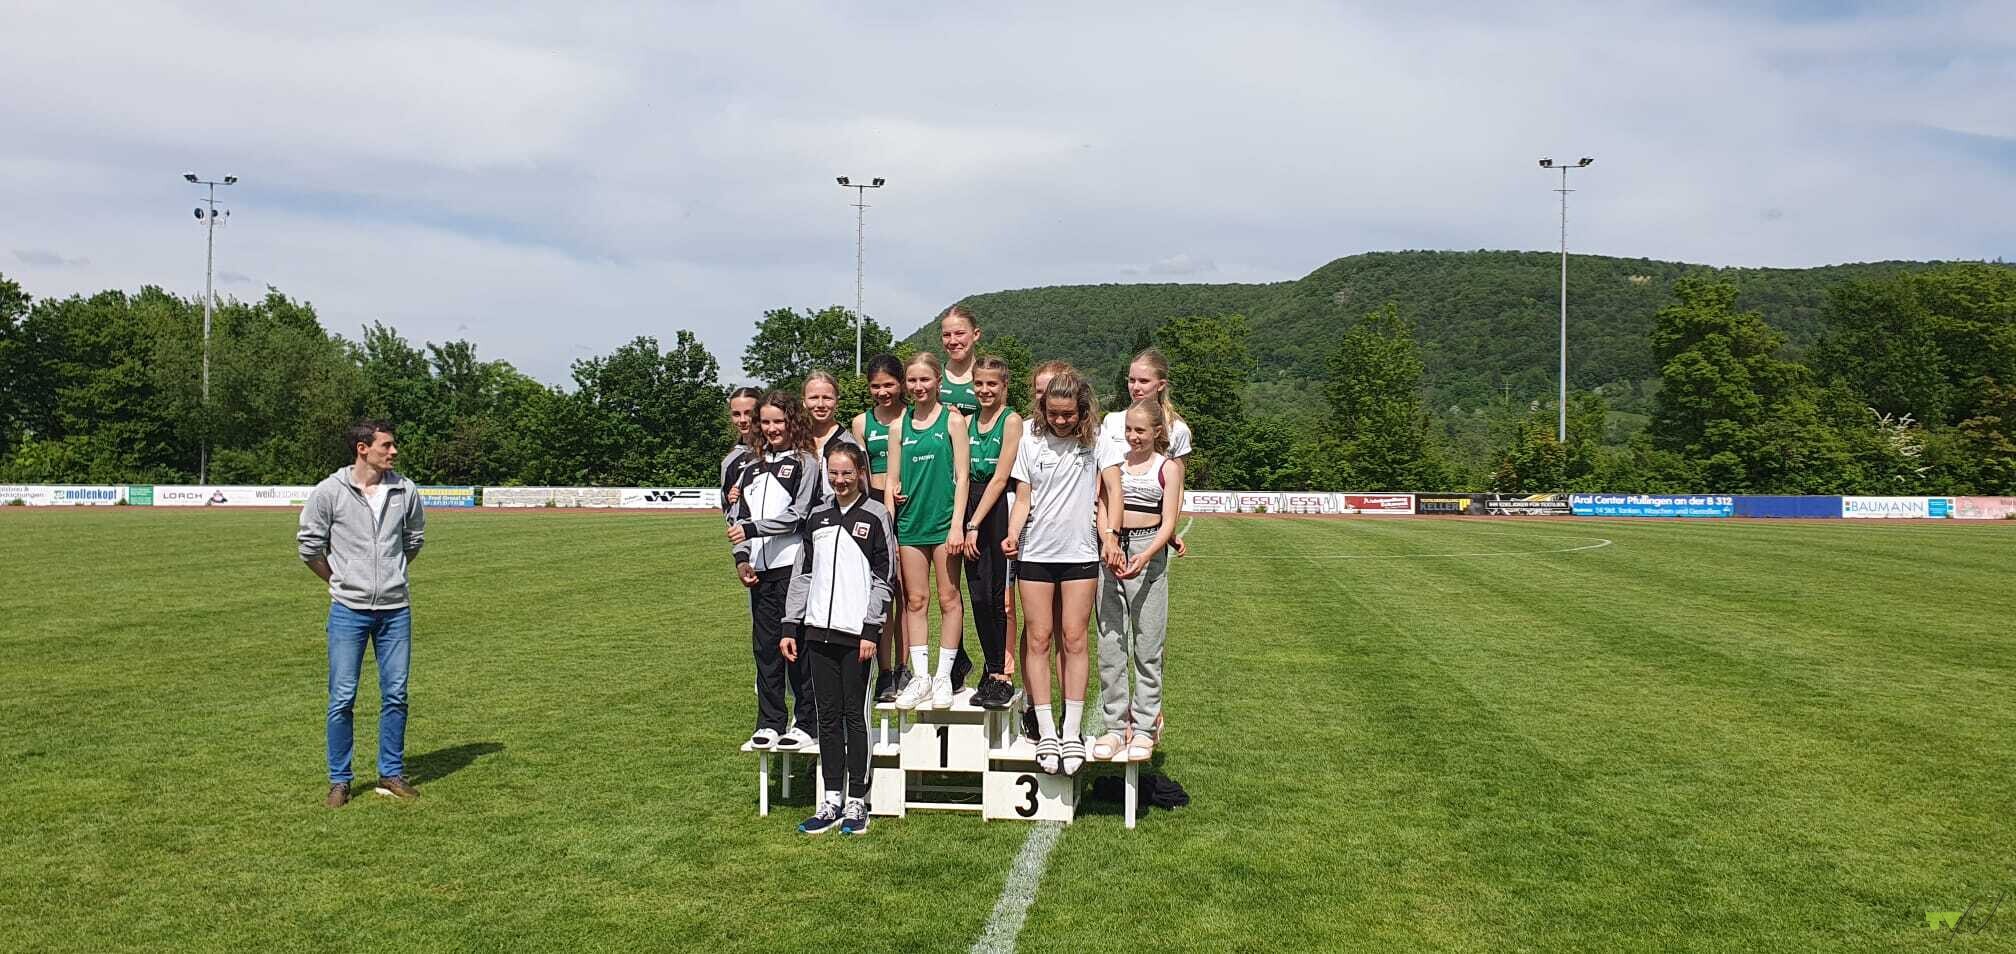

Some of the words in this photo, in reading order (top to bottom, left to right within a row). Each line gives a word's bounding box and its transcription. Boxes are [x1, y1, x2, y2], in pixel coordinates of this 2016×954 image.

[1421, 503, 1459, 511] KELLER
[1574, 496, 1593, 504] Aral
[1595, 496, 1626, 504] Center
[1627, 495, 1673, 507] Pfullingen
[1688, 497, 1706, 505] der
[1707, 497, 1714, 505] B
[1715, 497, 1733, 506] 312
[1852, 500, 1923, 512] BAUMANN
[936, 726, 949, 768] 1
[1015, 774, 1039, 818] 3
